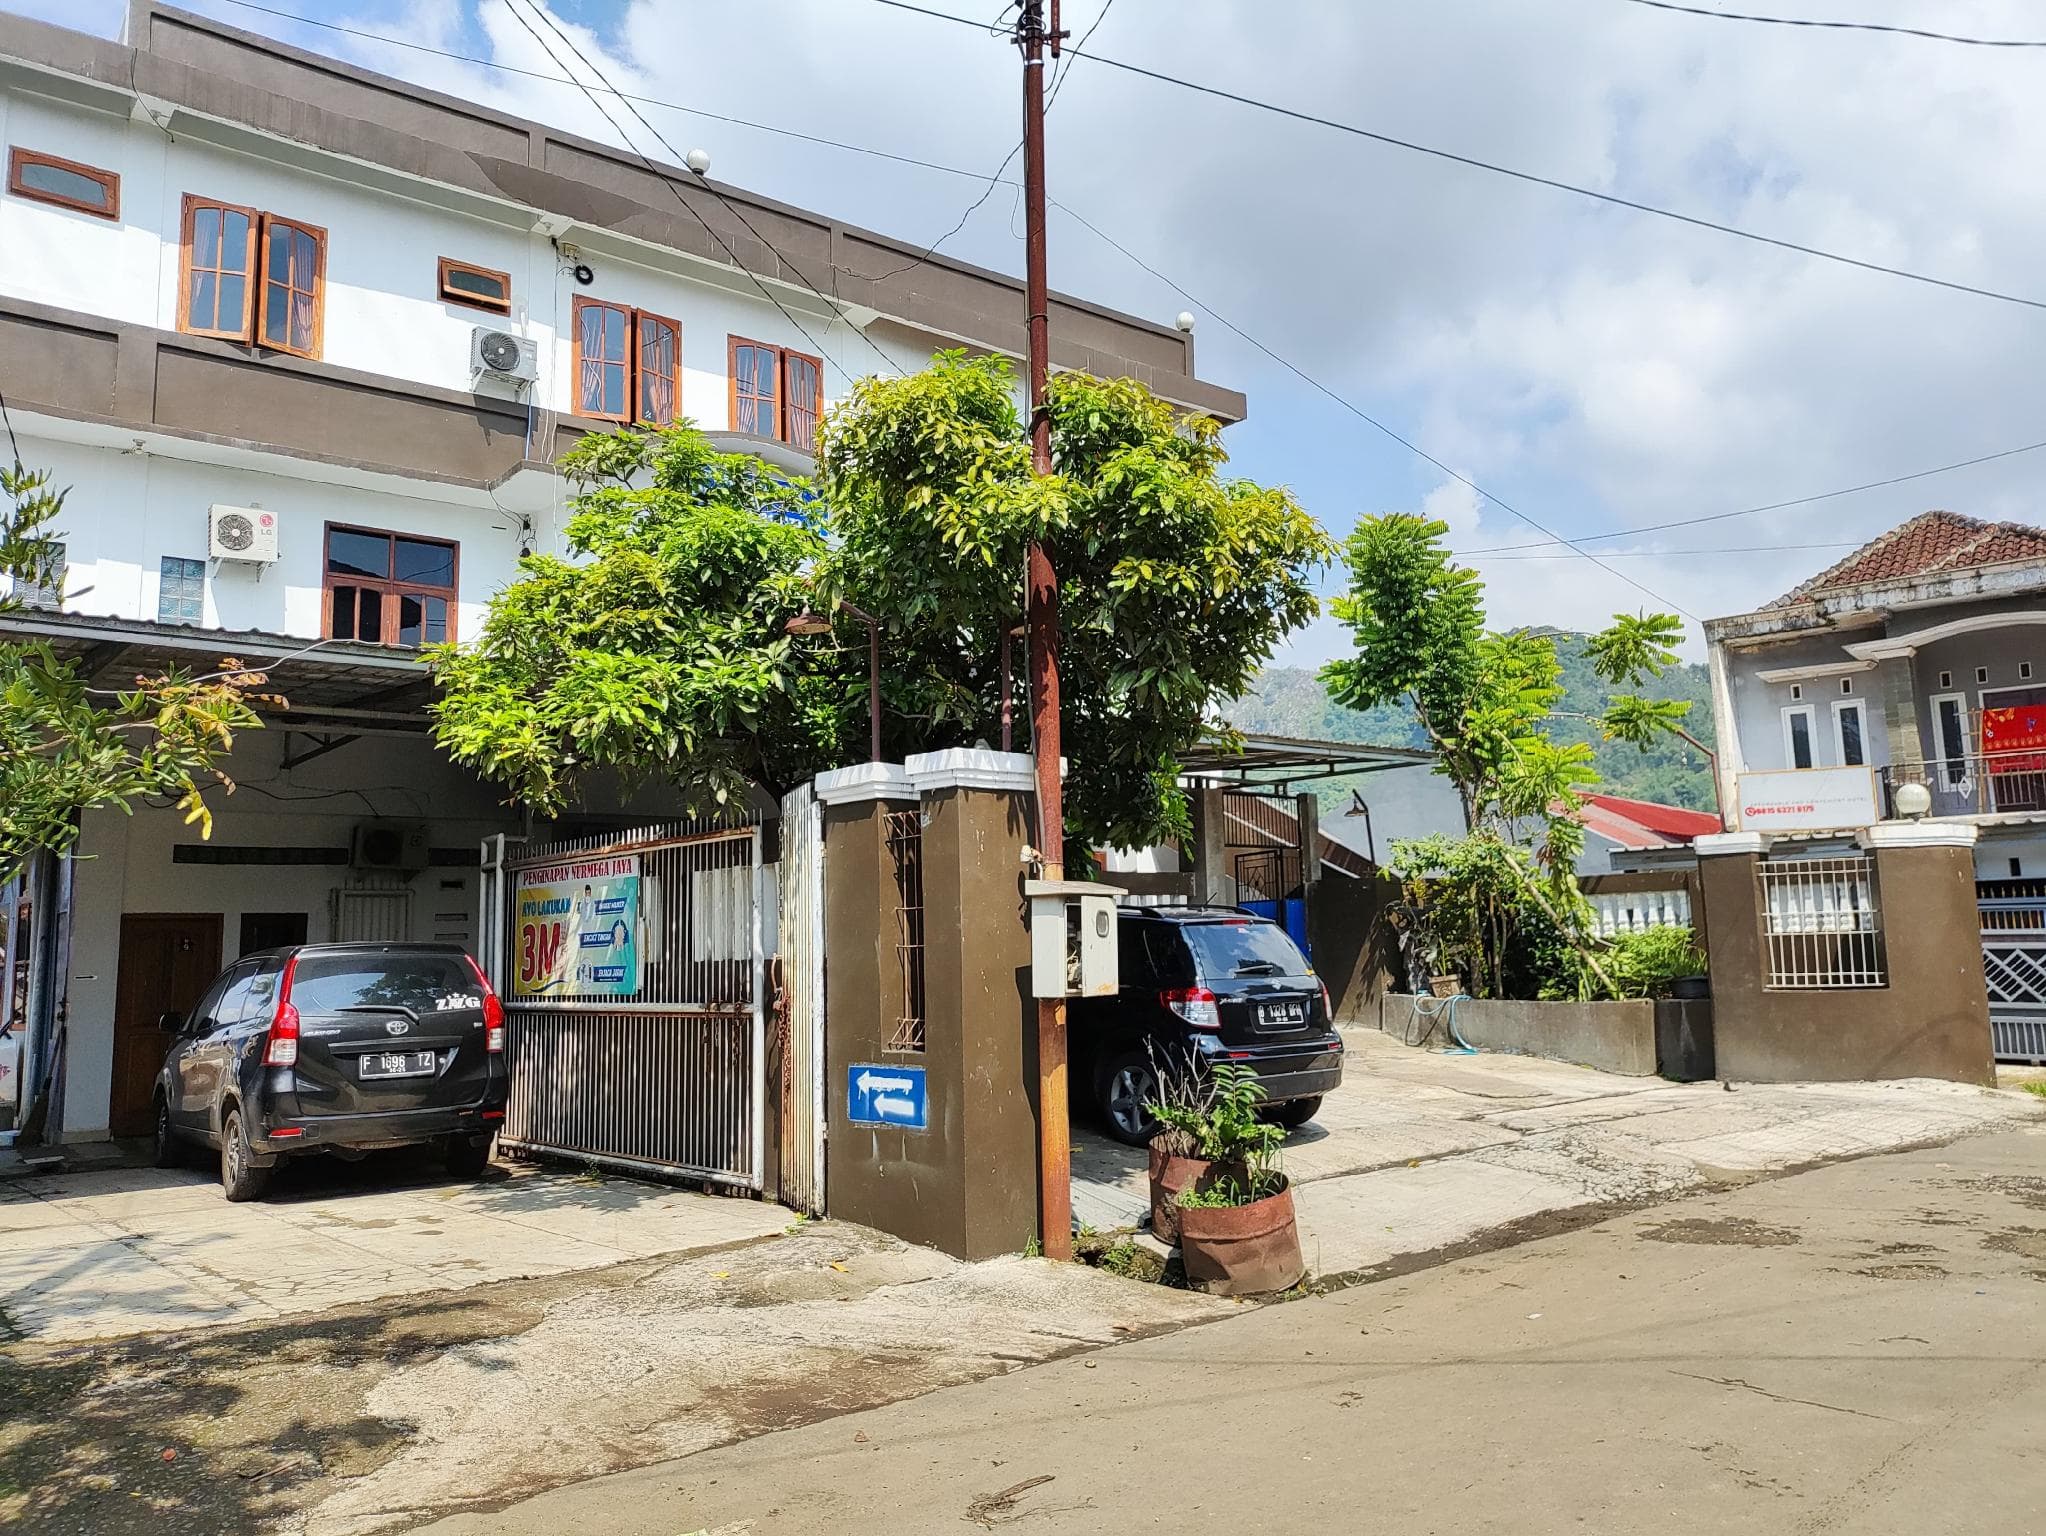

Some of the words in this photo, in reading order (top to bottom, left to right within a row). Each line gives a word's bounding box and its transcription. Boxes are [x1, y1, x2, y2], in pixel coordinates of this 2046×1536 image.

[523, 866, 570, 886] PENGINAPAN
[571, 861, 610, 881] NURMEGA
[612, 858, 632, 877] JAYA
[522, 901, 536, 917] AYO
[537, 897, 572, 916] LAKUKAN
[521, 922, 561, 983] 3M
[363, 1056, 371, 1070] F
[381, 1055, 406, 1070] 1696
[418, 1053, 431, 1067] TZ
